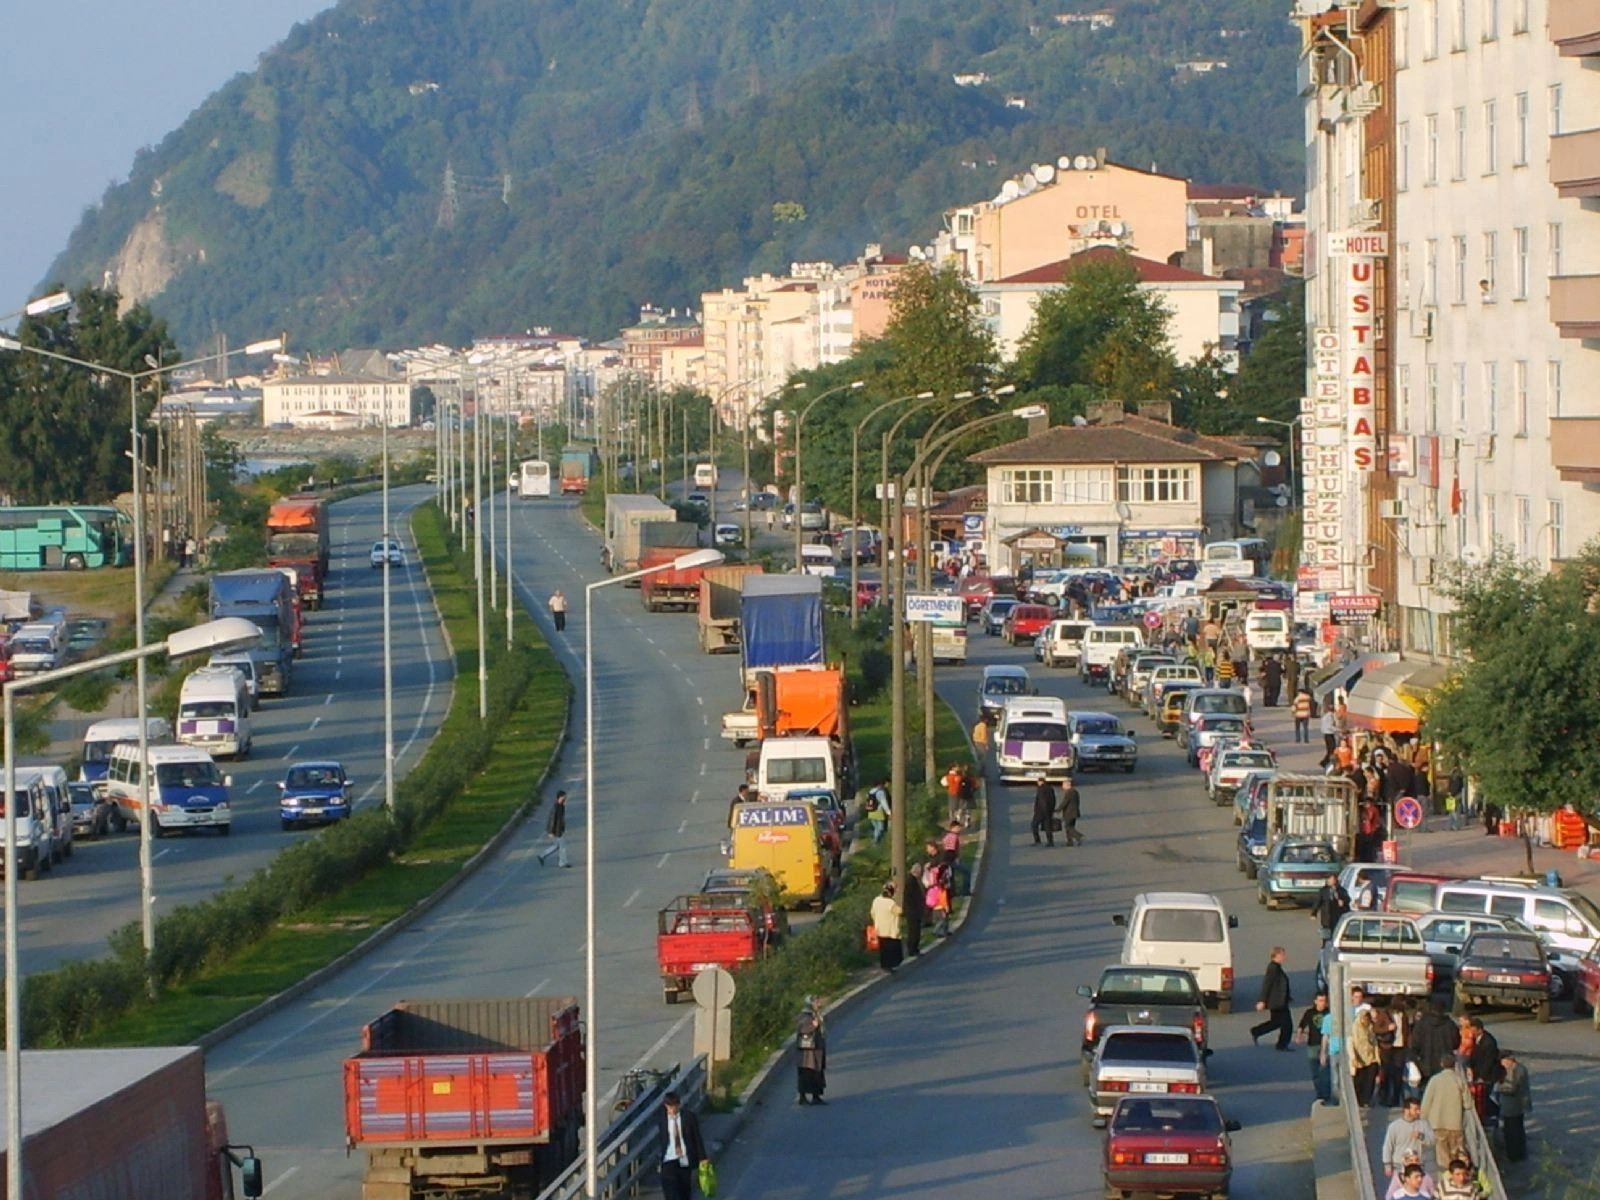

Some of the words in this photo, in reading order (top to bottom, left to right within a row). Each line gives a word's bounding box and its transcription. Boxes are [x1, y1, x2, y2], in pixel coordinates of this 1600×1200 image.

[1076, 205, 1121, 219] OTEL
[1346, 236, 1385, 253] HOTEL
[1319, 335, 1339, 419] OTEL
[1304, 401, 1313, 472] HOTEL
[1319, 454, 1339, 561] HUZUR
